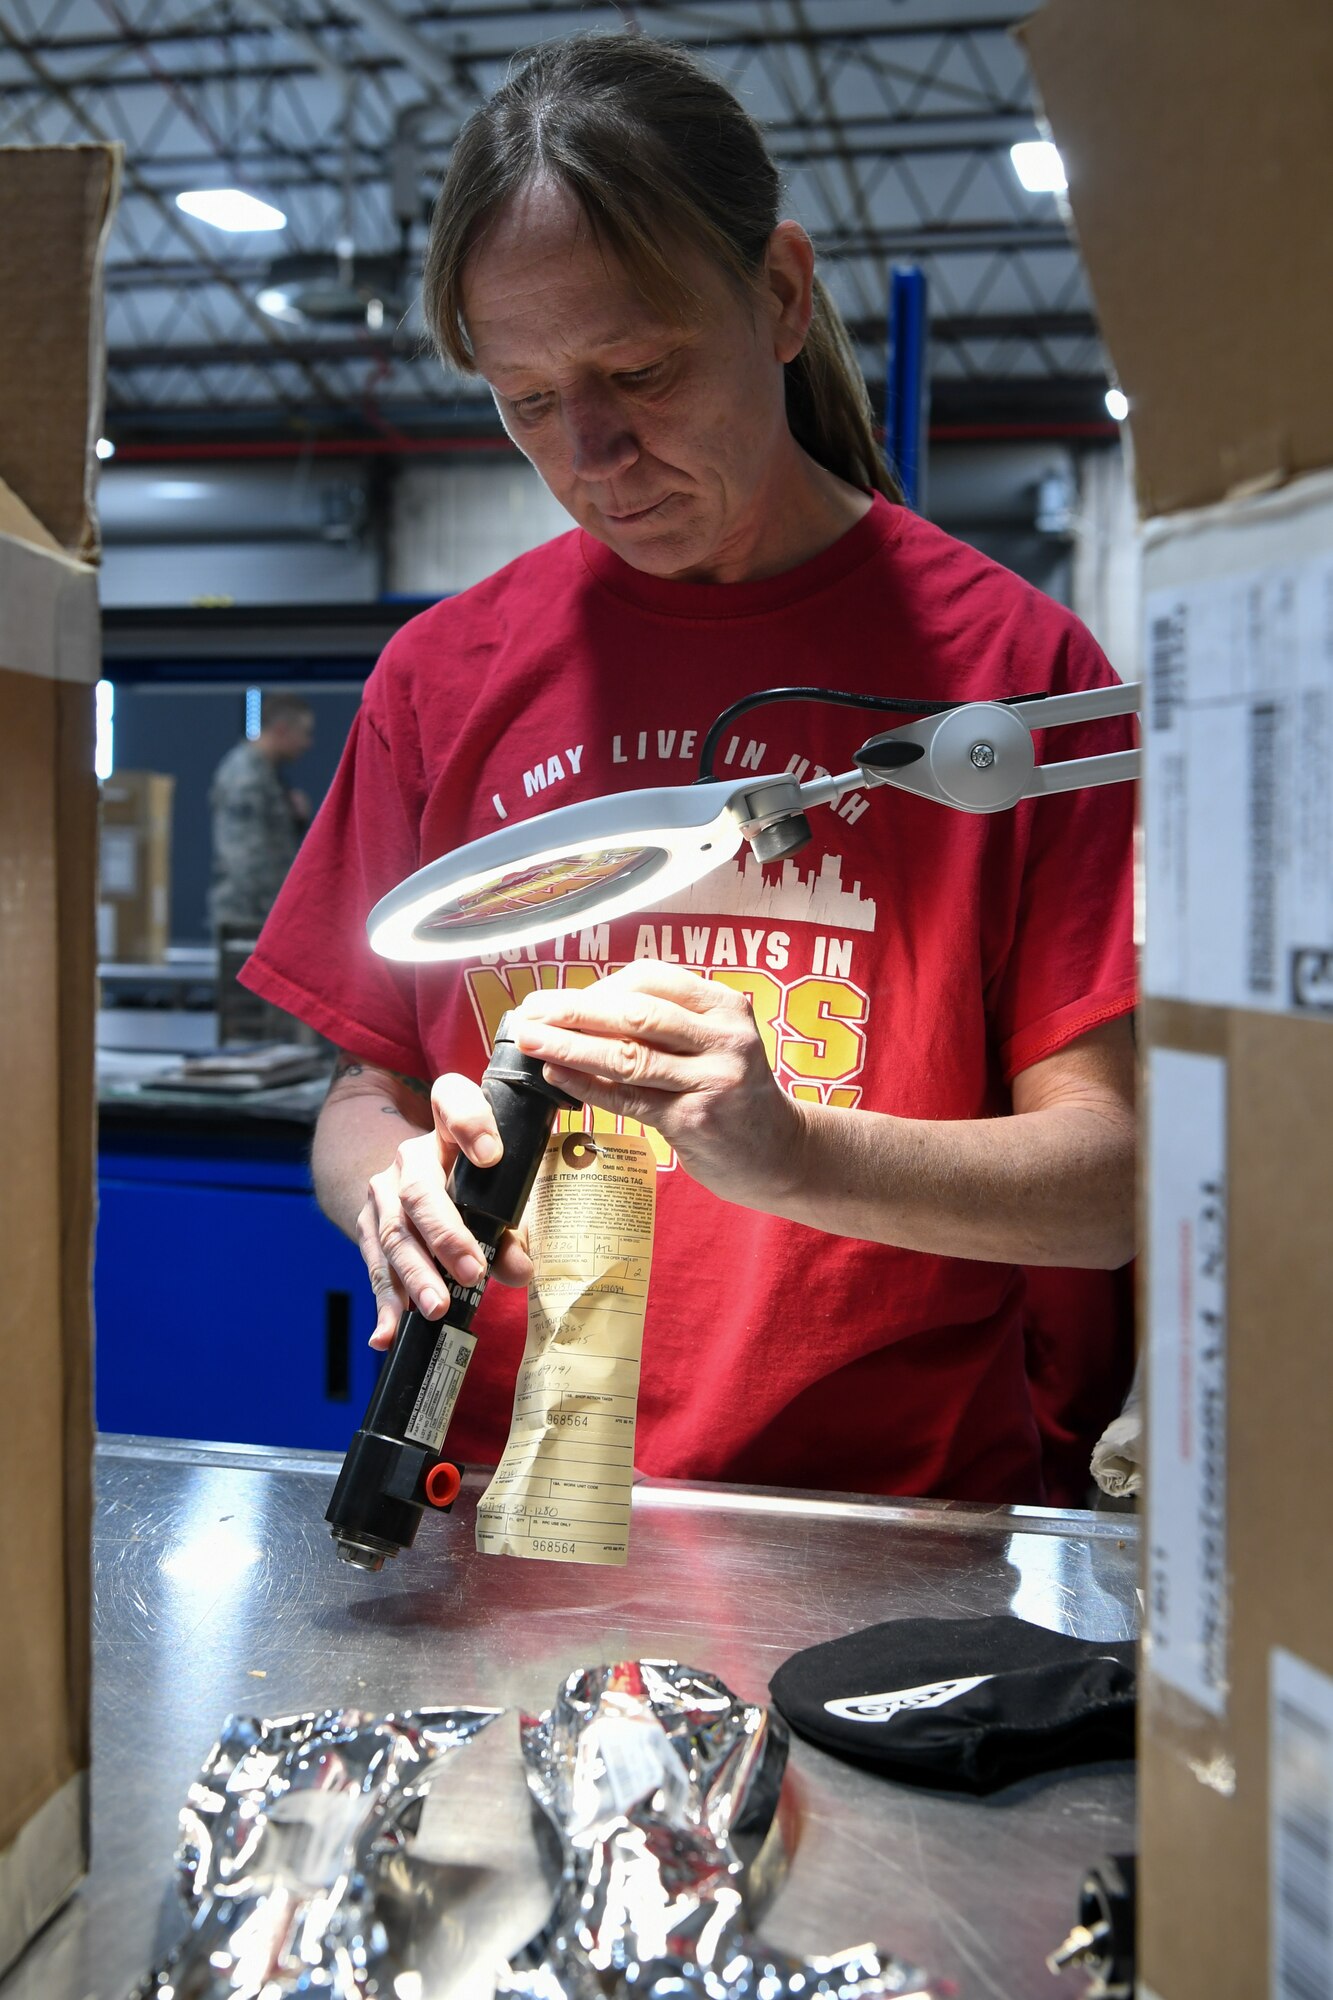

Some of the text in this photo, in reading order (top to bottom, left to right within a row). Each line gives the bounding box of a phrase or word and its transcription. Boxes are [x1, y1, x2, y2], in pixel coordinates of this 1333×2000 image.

[491, 794, 508, 820] I
[522, 745, 584, 798] MAY
[613, 730, 698, 763] LIVE
[724, 735, 767, 771] IN
[634, 925, 790, 970] ALWAYS
[812, 936, 853, 978] IN
[559, 1173, 578, 1181] ITEM
[580, 1174, 629, 1184] PROCESSING
[547, 1413, 588, 1427] 968564
[532, 1540, 576, 1555] 968564
